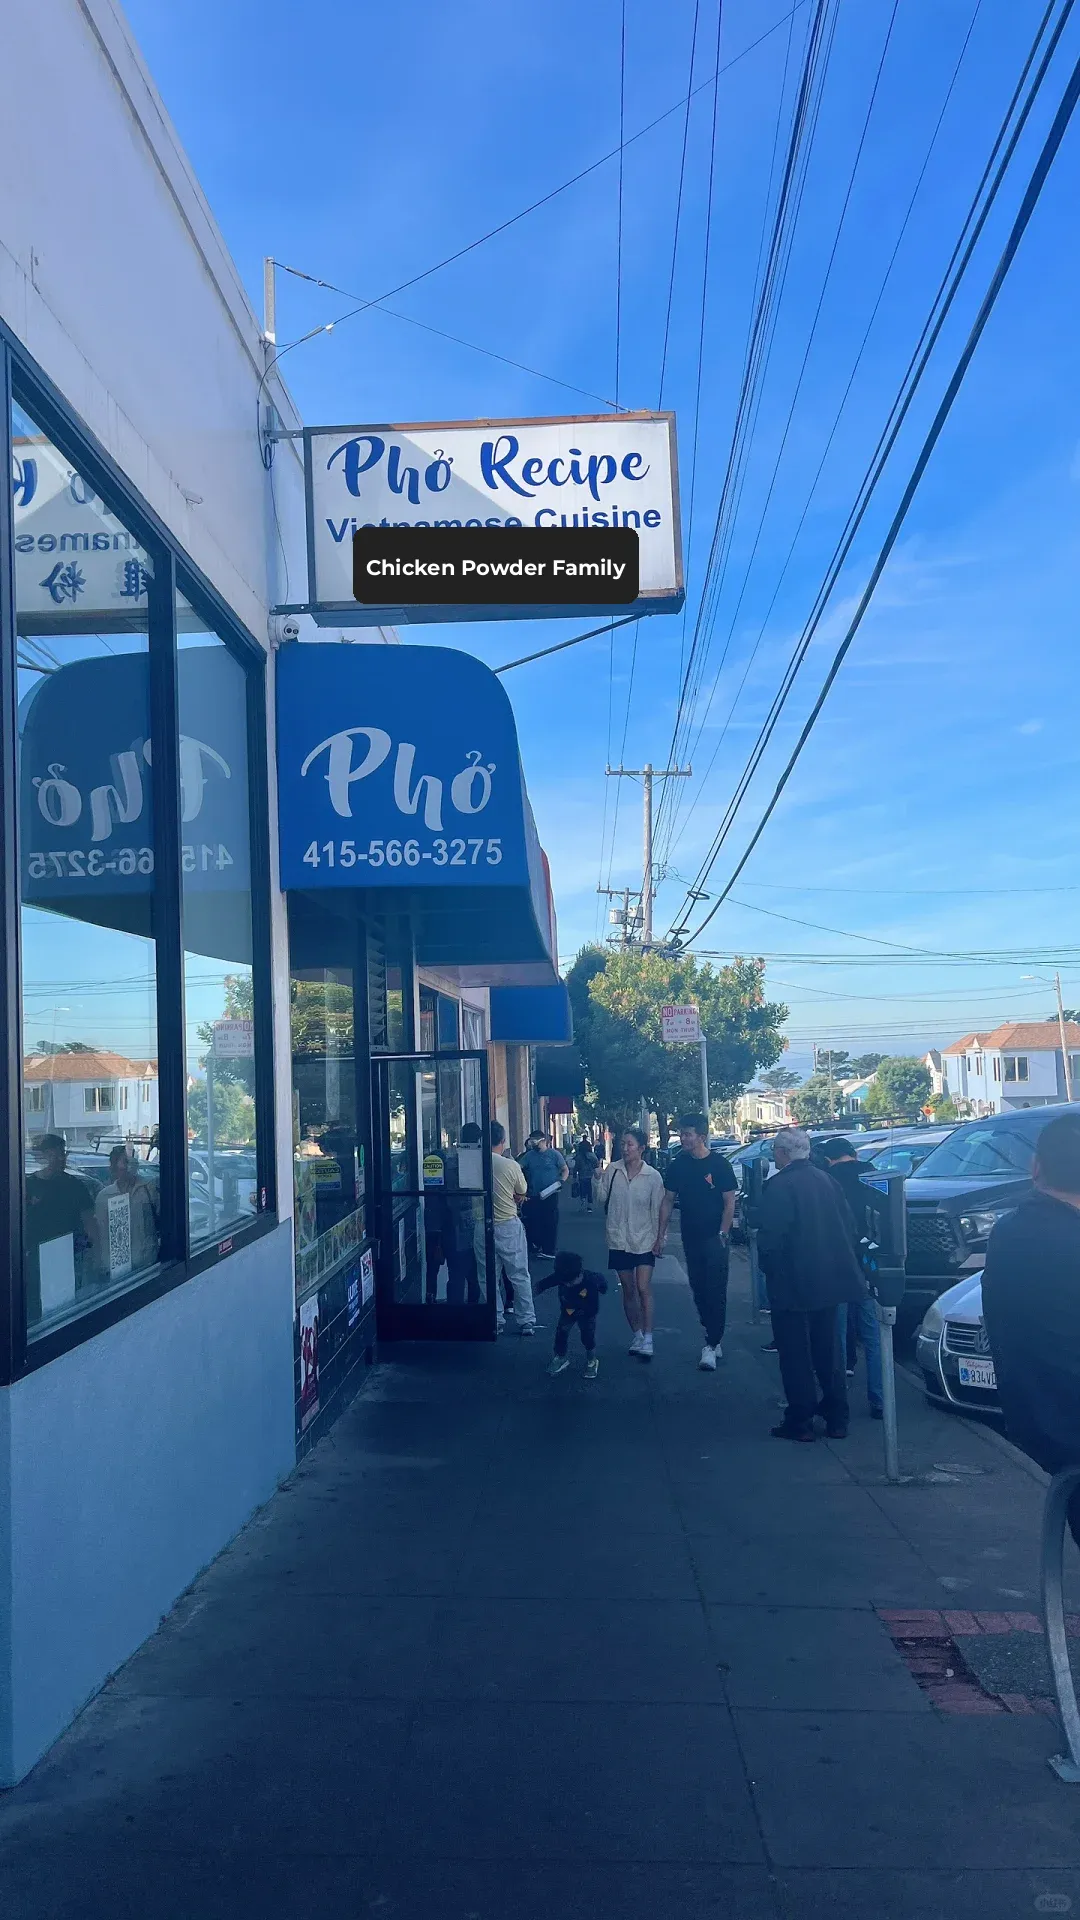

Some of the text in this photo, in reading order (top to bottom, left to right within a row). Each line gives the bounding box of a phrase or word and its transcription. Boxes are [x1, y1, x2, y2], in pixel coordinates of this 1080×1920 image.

[327, 435, 651, 504] Phở Recipe
[534, 504, 662, 528] Cuisine
[301, 726, 497, 832] Phở
[302, 838, 503, 868] 415-566-3275
[663, 1007, 673, 1017] NO
